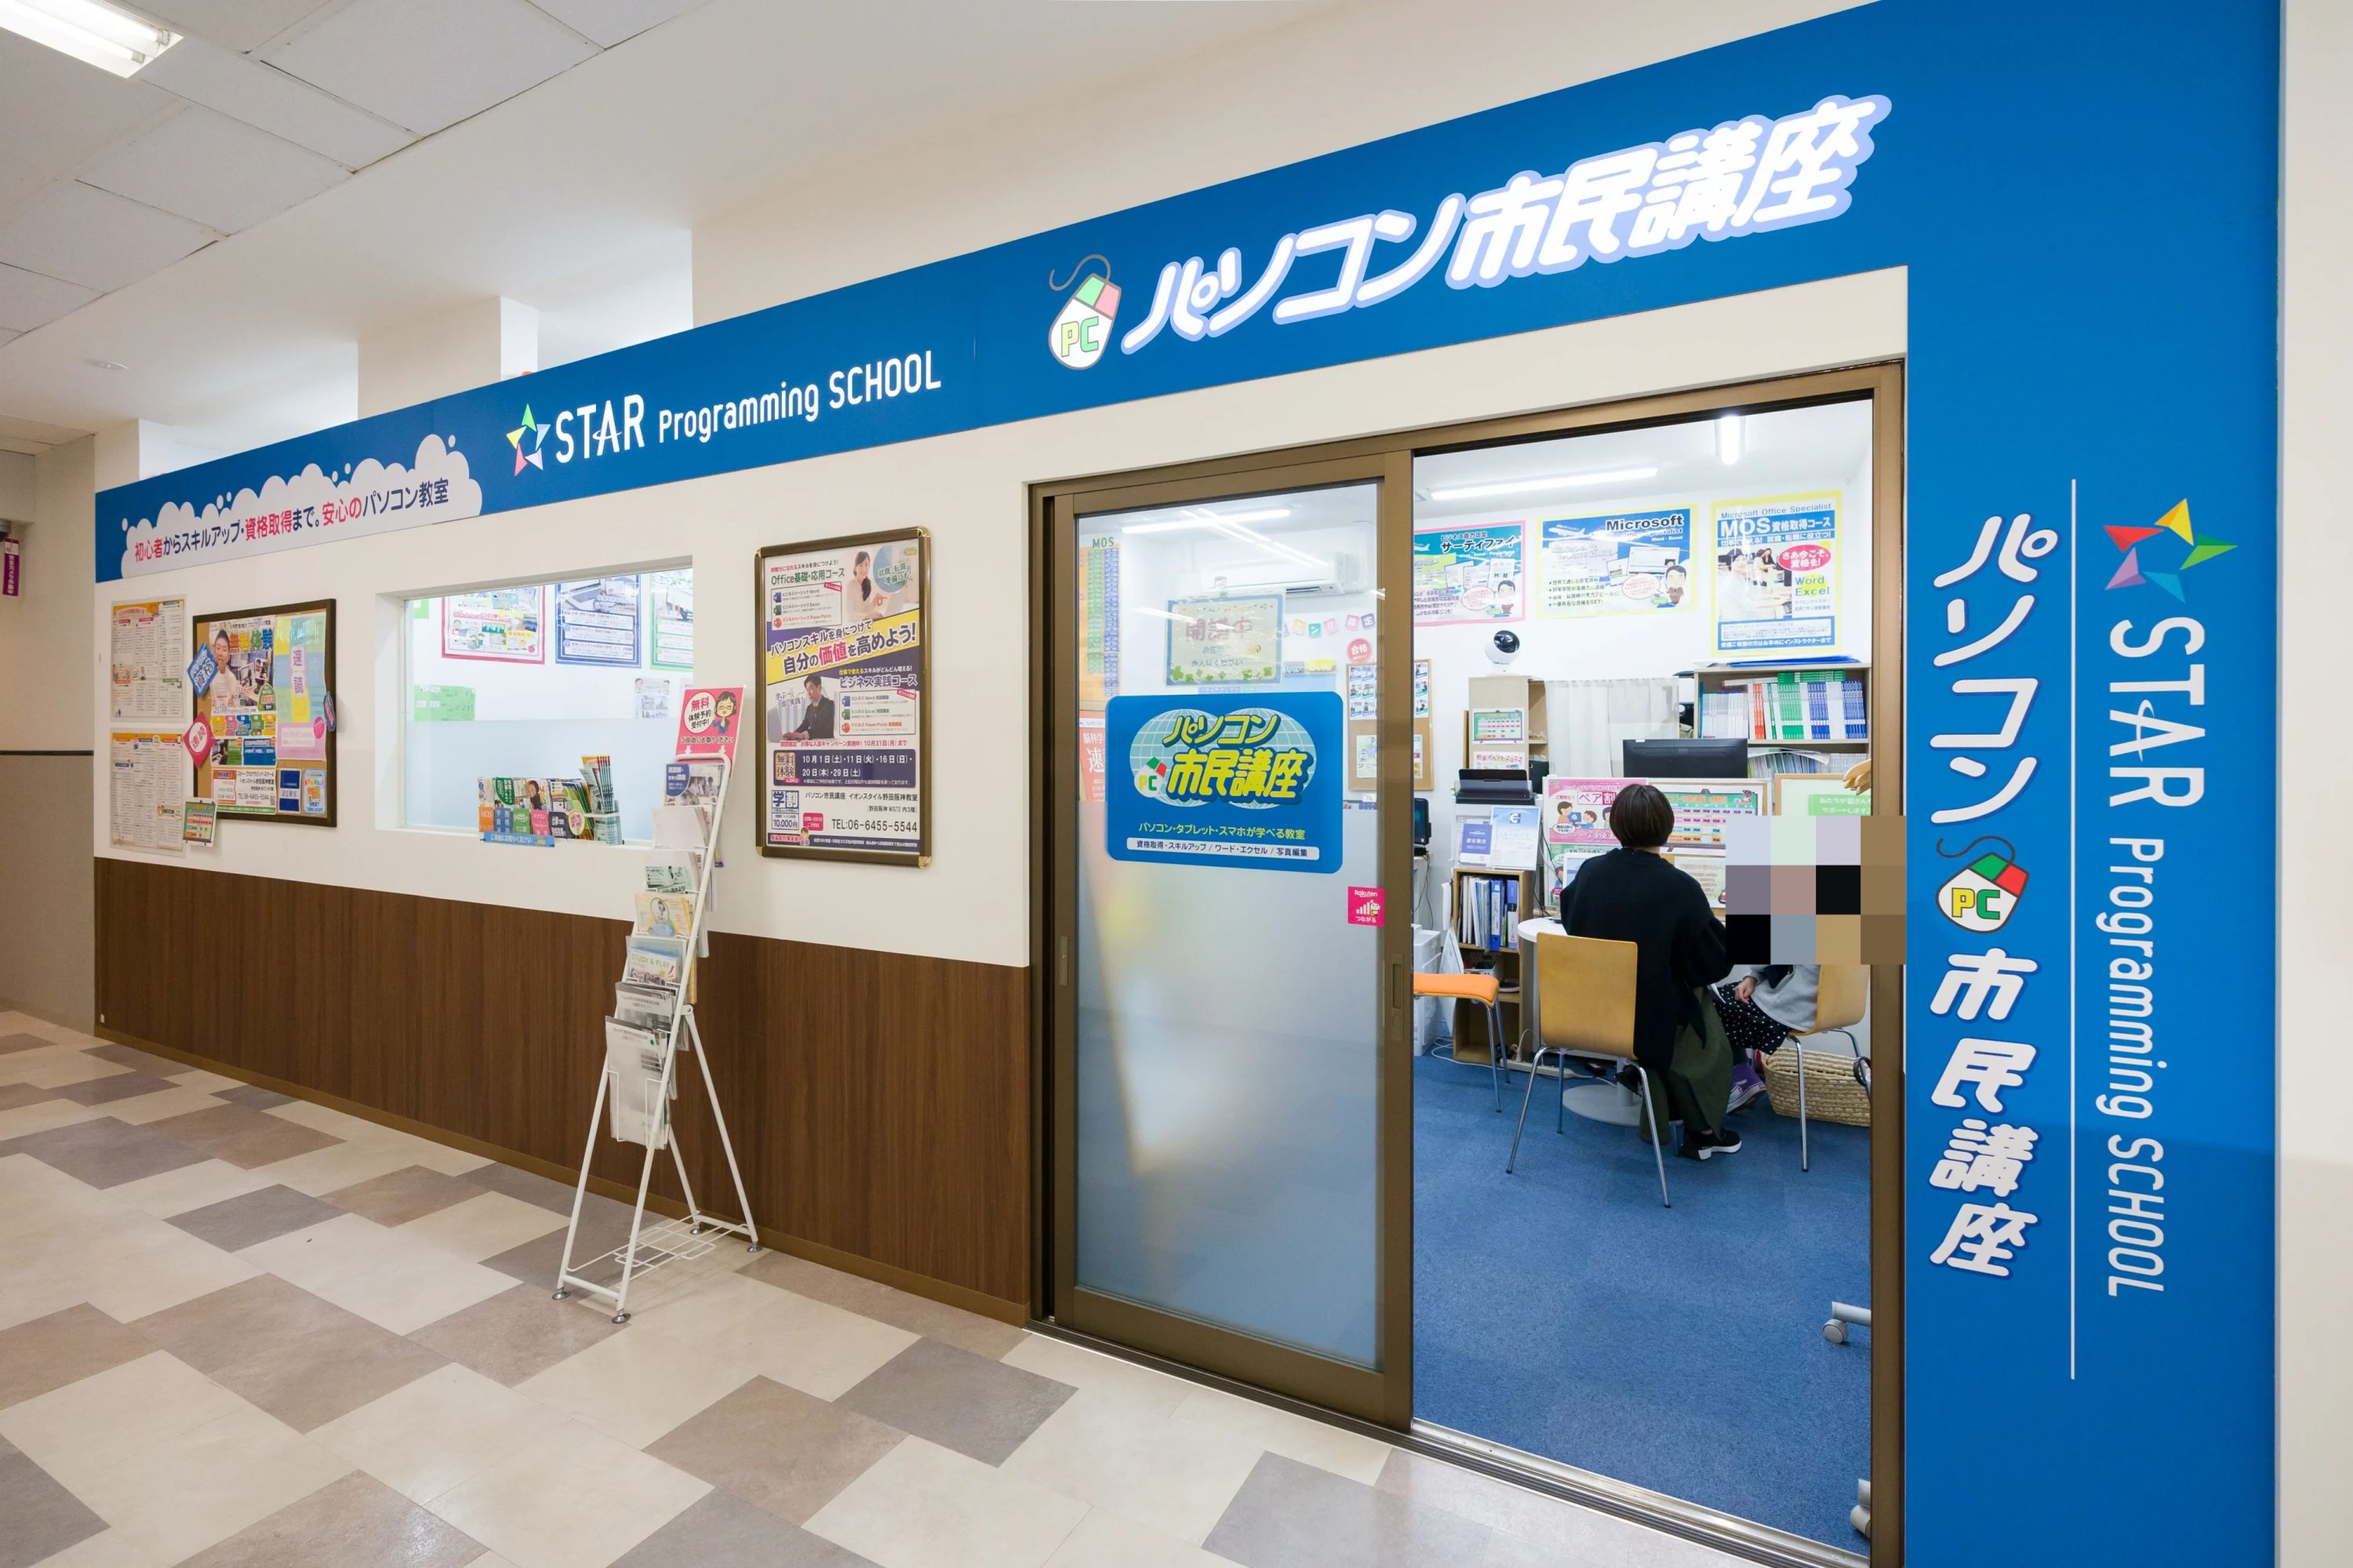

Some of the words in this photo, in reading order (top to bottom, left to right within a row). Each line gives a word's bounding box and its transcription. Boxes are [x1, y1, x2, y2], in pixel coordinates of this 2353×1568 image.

[1123, 95, 1891, 353] パソコン市民講座
[1061, 315, 1100, 358] PC
[555, 394, 646, 464] STAR
[659, 381, 820, 443] Programming
[828, 350, 942, 409] SCHOOL
[1721, 510, 1758, 518] Microsoft
[1790, 503, 1832, 513] Specialist
[1606, 514, 1684, 531] Microsoft
[1720, 517, 1771, 537] MOS
[1772, 517, 1831, 533] 資格取得コース
[1093, 537, 1115, 548] MOS
[1442, 536, 1515, 552] サーティファイ
[771, 568, 846, 585] Office基礎・応用コース
[1795, 576, 1825, 585] Word
[1795, 587, 1830, 596] Excel
[771, 620, 872, 657] パソコンスキルを身につけて
[784, 622, 917, 675] 自分の価値を高めよう！
[1929, 513, 2059, 824] パソコン
[839, 674, 918, 689] ビジネス実践コース
[691, 696, 710, 712] 無料
[2109, 617, 2206, 807] STAR
[688, 709, 712, 722] 体験予約
[691, 719, 710, 729] 受付中！
[680, 735, 734, 744] ご自由にお取りください
[1162, 714, 1281, 748] パソコン
[1166, 747, 1311, 800] 市民講座
[1138, 775, 1158, 792] PC
[831, 818, 918, 833] TEL:06-6455-5544
[1138, 822, 1306, 840] パソコン・タブレット・スマホが学べる教室
[1951, 887, 2001, 921] PC
[631, 954, 649, 964] STUDY
[656, 959, 671, 968] PLAY
[2095, 837, 2167, 1119] Programming
[1929, 947, 2038, 1278] 市民講座
[2107, 1134, 2165, 1297] SCHOOL
